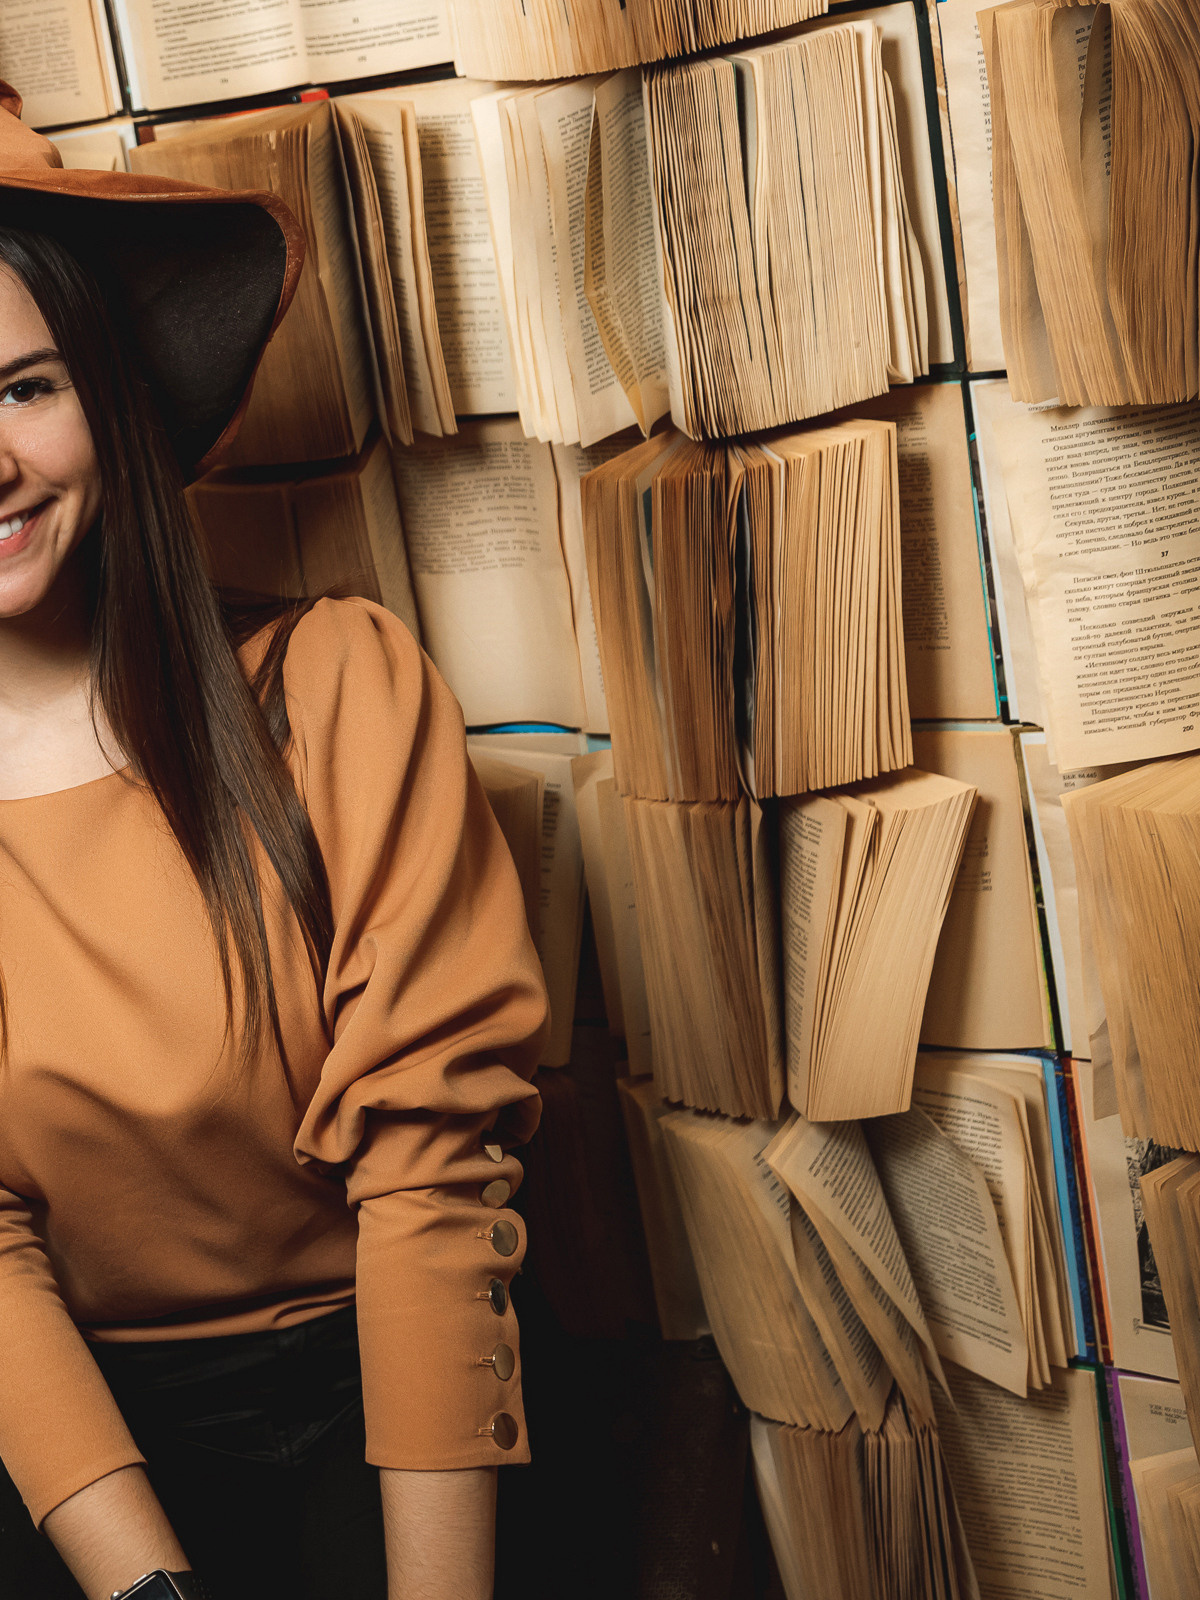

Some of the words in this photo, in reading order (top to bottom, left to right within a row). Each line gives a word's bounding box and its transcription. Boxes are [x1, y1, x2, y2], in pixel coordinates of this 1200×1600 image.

[1051, 423, 1079, 432] Мюллер
[1092, 454, 1131, 465] поговорить
[1072, 466, 1120, 478] Возвращаться
[1129, 476, 1167, 488] количеству
[1056, 531, 1083, 539] опустил
[1086, 526, 1115, 534] пистолет
[1109, 531, 1143, 541] следовало
[1120, 571, 1134, 579] фон
[1148, 570, 1180, 584] усеянный
[1127, 584, 1169, 598] французская
[1172, 577, 1197, 587] столица
[1080, 622, 1116, 631] Несколько
[1122, 614, 1155, 626] созвездий
[1161, 607, 1193, 619] окружали
[1072, 642, 1105, 652] огромный
[1108, 634, 1151, 647] голубоватый
[1084, 653, 1106, 661] султан
[1129, 654, 1155, 663] солдату
[1141, 662, 1164, 670] словно
[1120, 674, 1149, 683] генералу
[1136, 701, 1158, 710] кресло
[1134, 710, 1154, 719] чтобы
[1117, 720, 1146, 731] военный
[1150, 714, 1186, 727] губернатор
